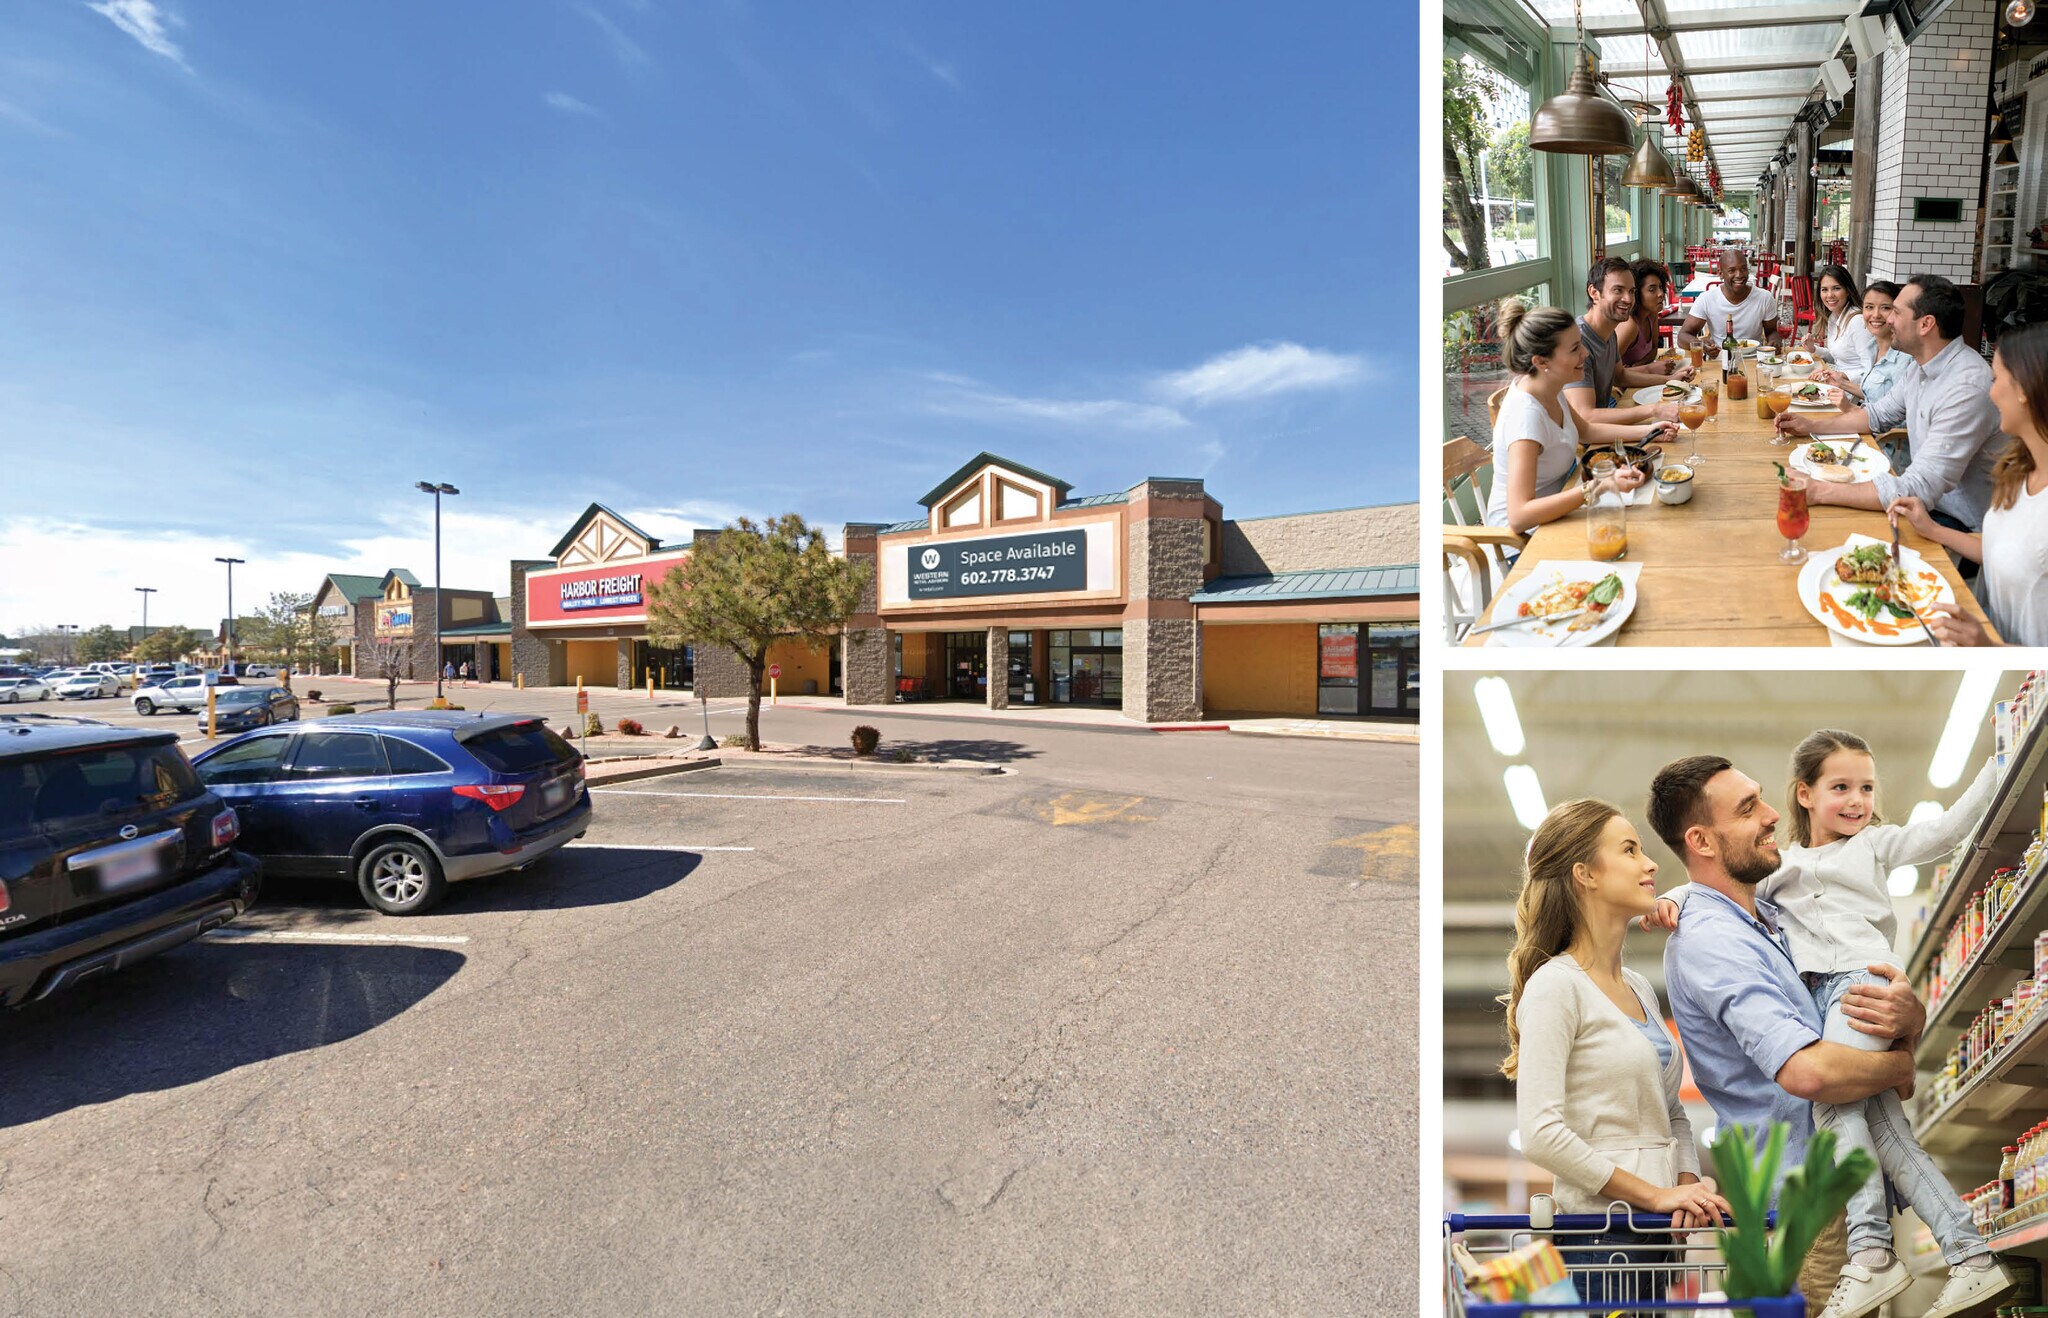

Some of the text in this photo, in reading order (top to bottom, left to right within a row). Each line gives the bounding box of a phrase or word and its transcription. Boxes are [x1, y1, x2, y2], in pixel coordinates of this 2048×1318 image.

[924, 554, 937, 565] W
[960, 541, 1076, 566] Space Available
[913, 571, 949, 580] WESTERN
[960, 566, 1055, 585] 602.778.3747
[560, 574, 641, 598] HARBOR FREIGHT
